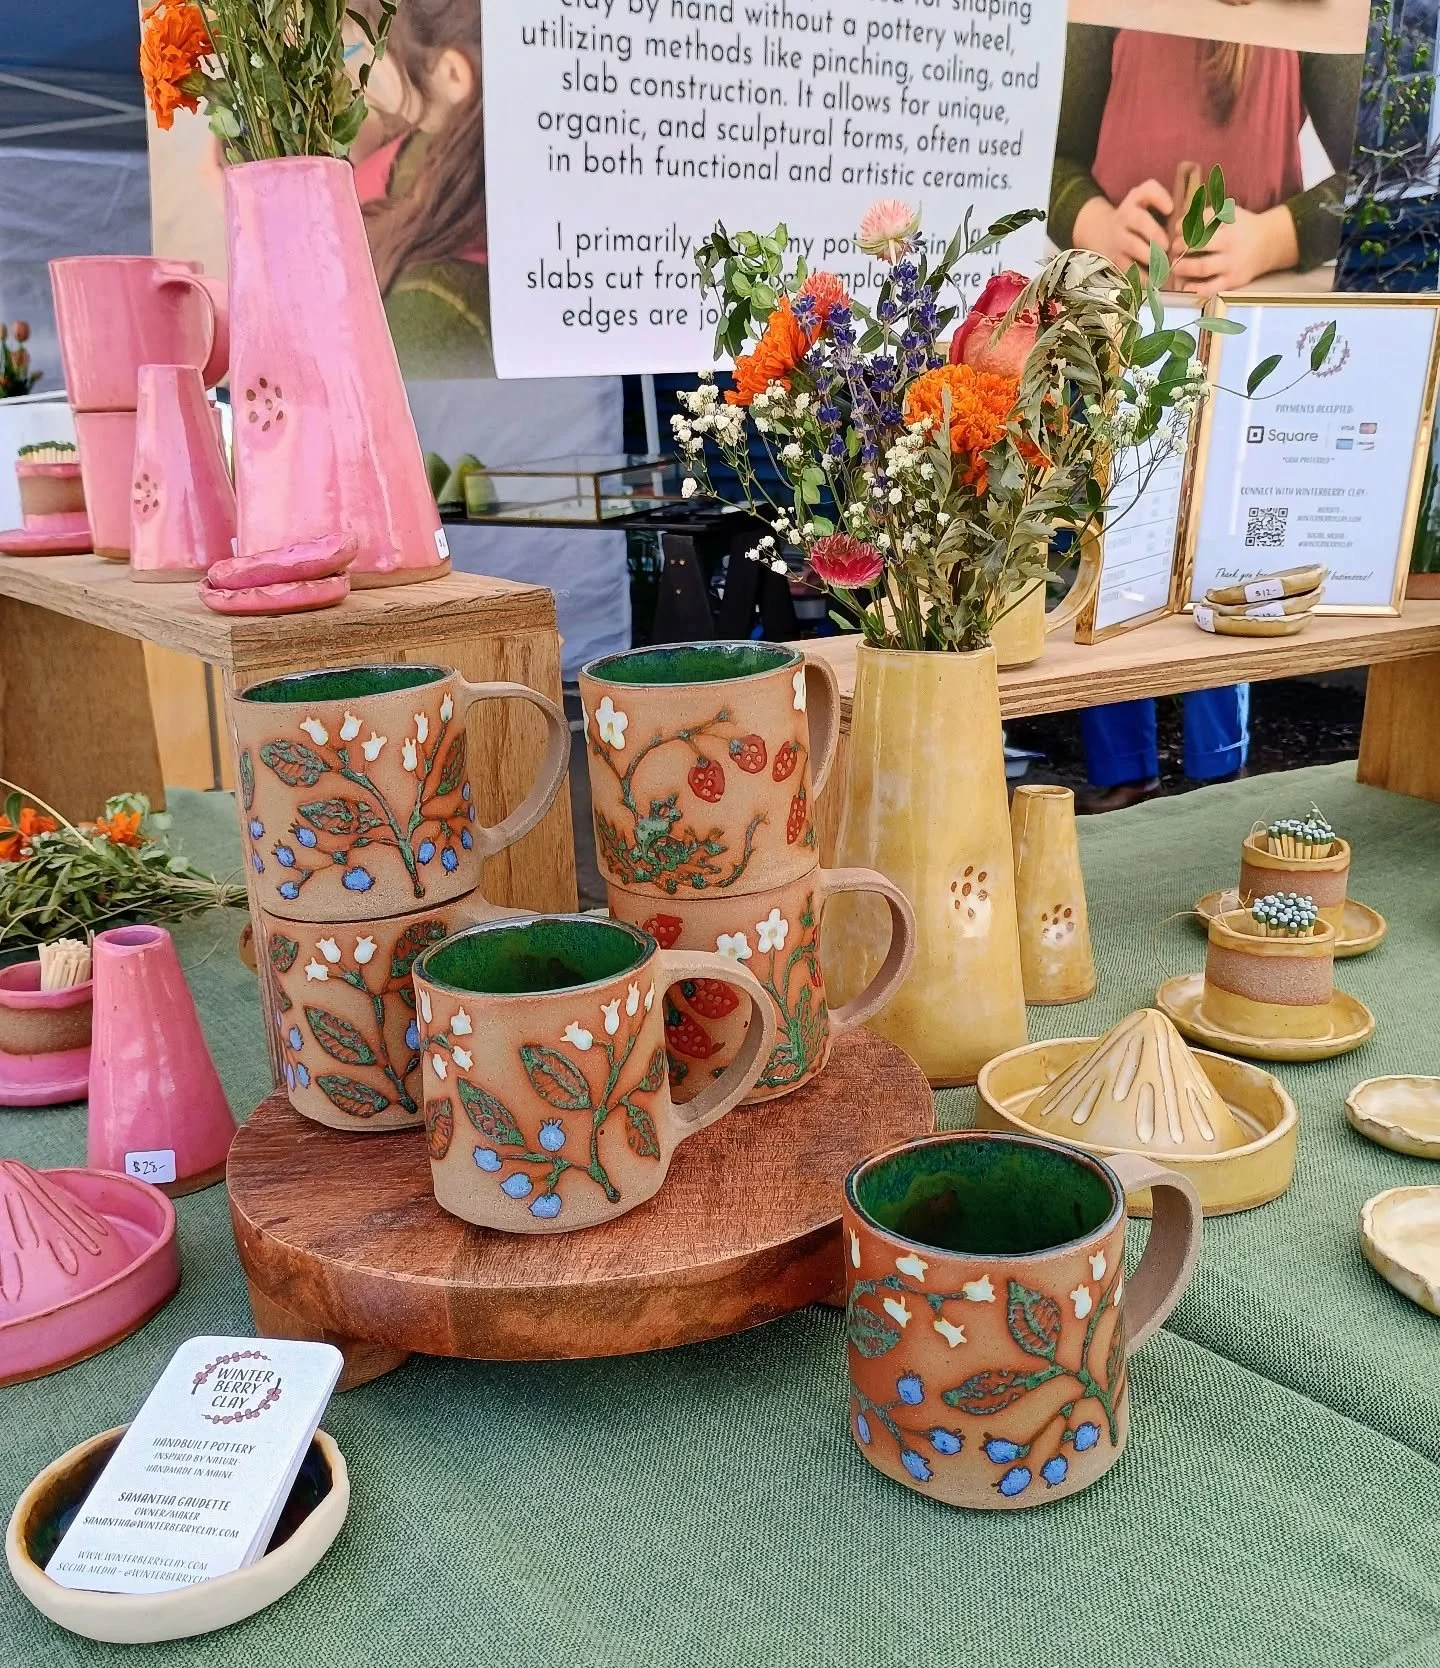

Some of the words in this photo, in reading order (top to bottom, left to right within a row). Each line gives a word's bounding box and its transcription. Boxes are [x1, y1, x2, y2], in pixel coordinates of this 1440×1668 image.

[671, 0, 734, 24] hand
[745, 2, 833, 34] without
[844, 16, 857, 37] a
[867, 17, 947, 51] pottery
[954, 20, 1016, 56] wheel,
[521, 14, 633, 62] utilizing
[646, 29, 753, 65] methods
[763, 34, 801, 69] like
[812, 45, 914, 85] pinching,
[921, 53, 994, 92] coiling,
[1002, 61, 1040, 90] and
[562, 58, 618, 94] slab
[629, 74, 788, 107] construction.
[797, 79, 814, 109] It
[823, 79, 891, 113] allows
[900, 85, 930, 117] for
[937, 95, 1011, 127] unique,
[537, 108, 647, 141] organic,
[657, 107, 706, 139] and
[716, 111, 833, 150] sculptural
[843, 118, 909, 155] forms,
[916, 123, 970, 155] often
[977, 128, 1024, 157] used
[547, 145, 571, 173] in
[583, 140, 643, 176] both
[655, 145, 779, 181] functional
[788, 153, 832, 183] and
[841, 159, 915, 187] artistic
[921, 165, 1013, 191] ceramics.
[557, 221, 562, 251] I
[575, 221, 692, 260] primarily
[527, 257, 595, 290] slabs
[605, 264, 645, 290] cut
[562, 295, 639, 333] edges
[649, 307, 689, 326] are
[1268, 429, 1319, 444] Square
[213, 1380, 262, 1395] BERRY
[217, 1367, 274, 1382] WINTER
[211, 1395, 249, 1409] CLAY
[152, 1437, 209, 1450] HANDBUILT
[210, 1440, 256, 1455] POTTERY
[118, 1491, 176, 1506] SAMANTHA
[178, 1496, 231, 1511] GAUDETTE
[134, 1507, 200, 1521] OWNER/MAKER
[83, 1516, 240, 1539] SAMANTHA@WINTERBERRYCLAY.COM
